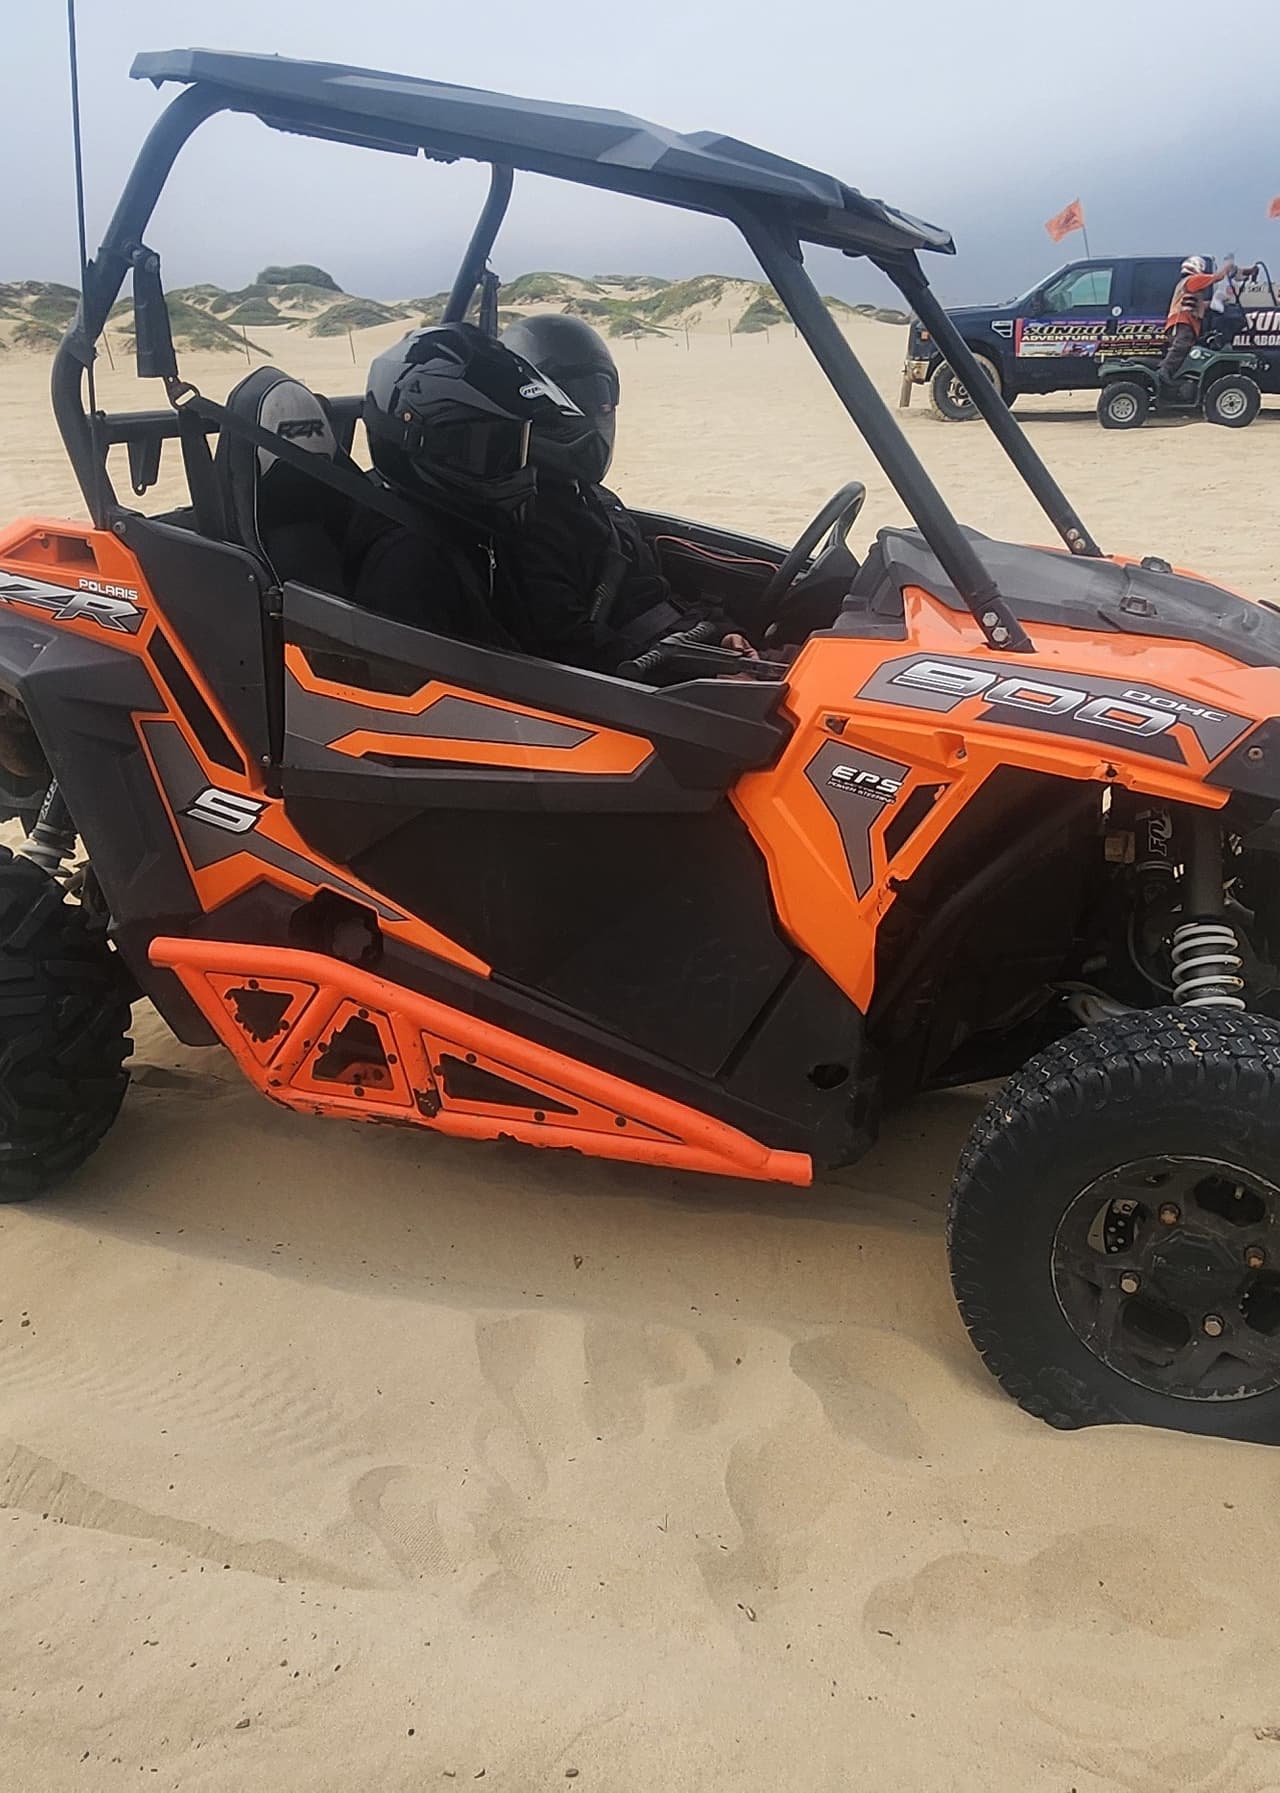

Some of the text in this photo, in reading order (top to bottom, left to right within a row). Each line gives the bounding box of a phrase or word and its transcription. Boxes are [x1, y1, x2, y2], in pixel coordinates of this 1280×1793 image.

[1022, 334, 1098, 342] ADVENTURE
[1101, 333, 1151, 341] STARTS
[1232, 335, 1251, 347] ALL
[277, 419, 325, 438] RZR
[78, 578, 138, 600] POLARIS
[892, 659, 1177, 737] 900
[1121, 689, 1228, 722] DOHC
[831, 764, 903, 793] EPS
[186, 787, 264, 834] S
